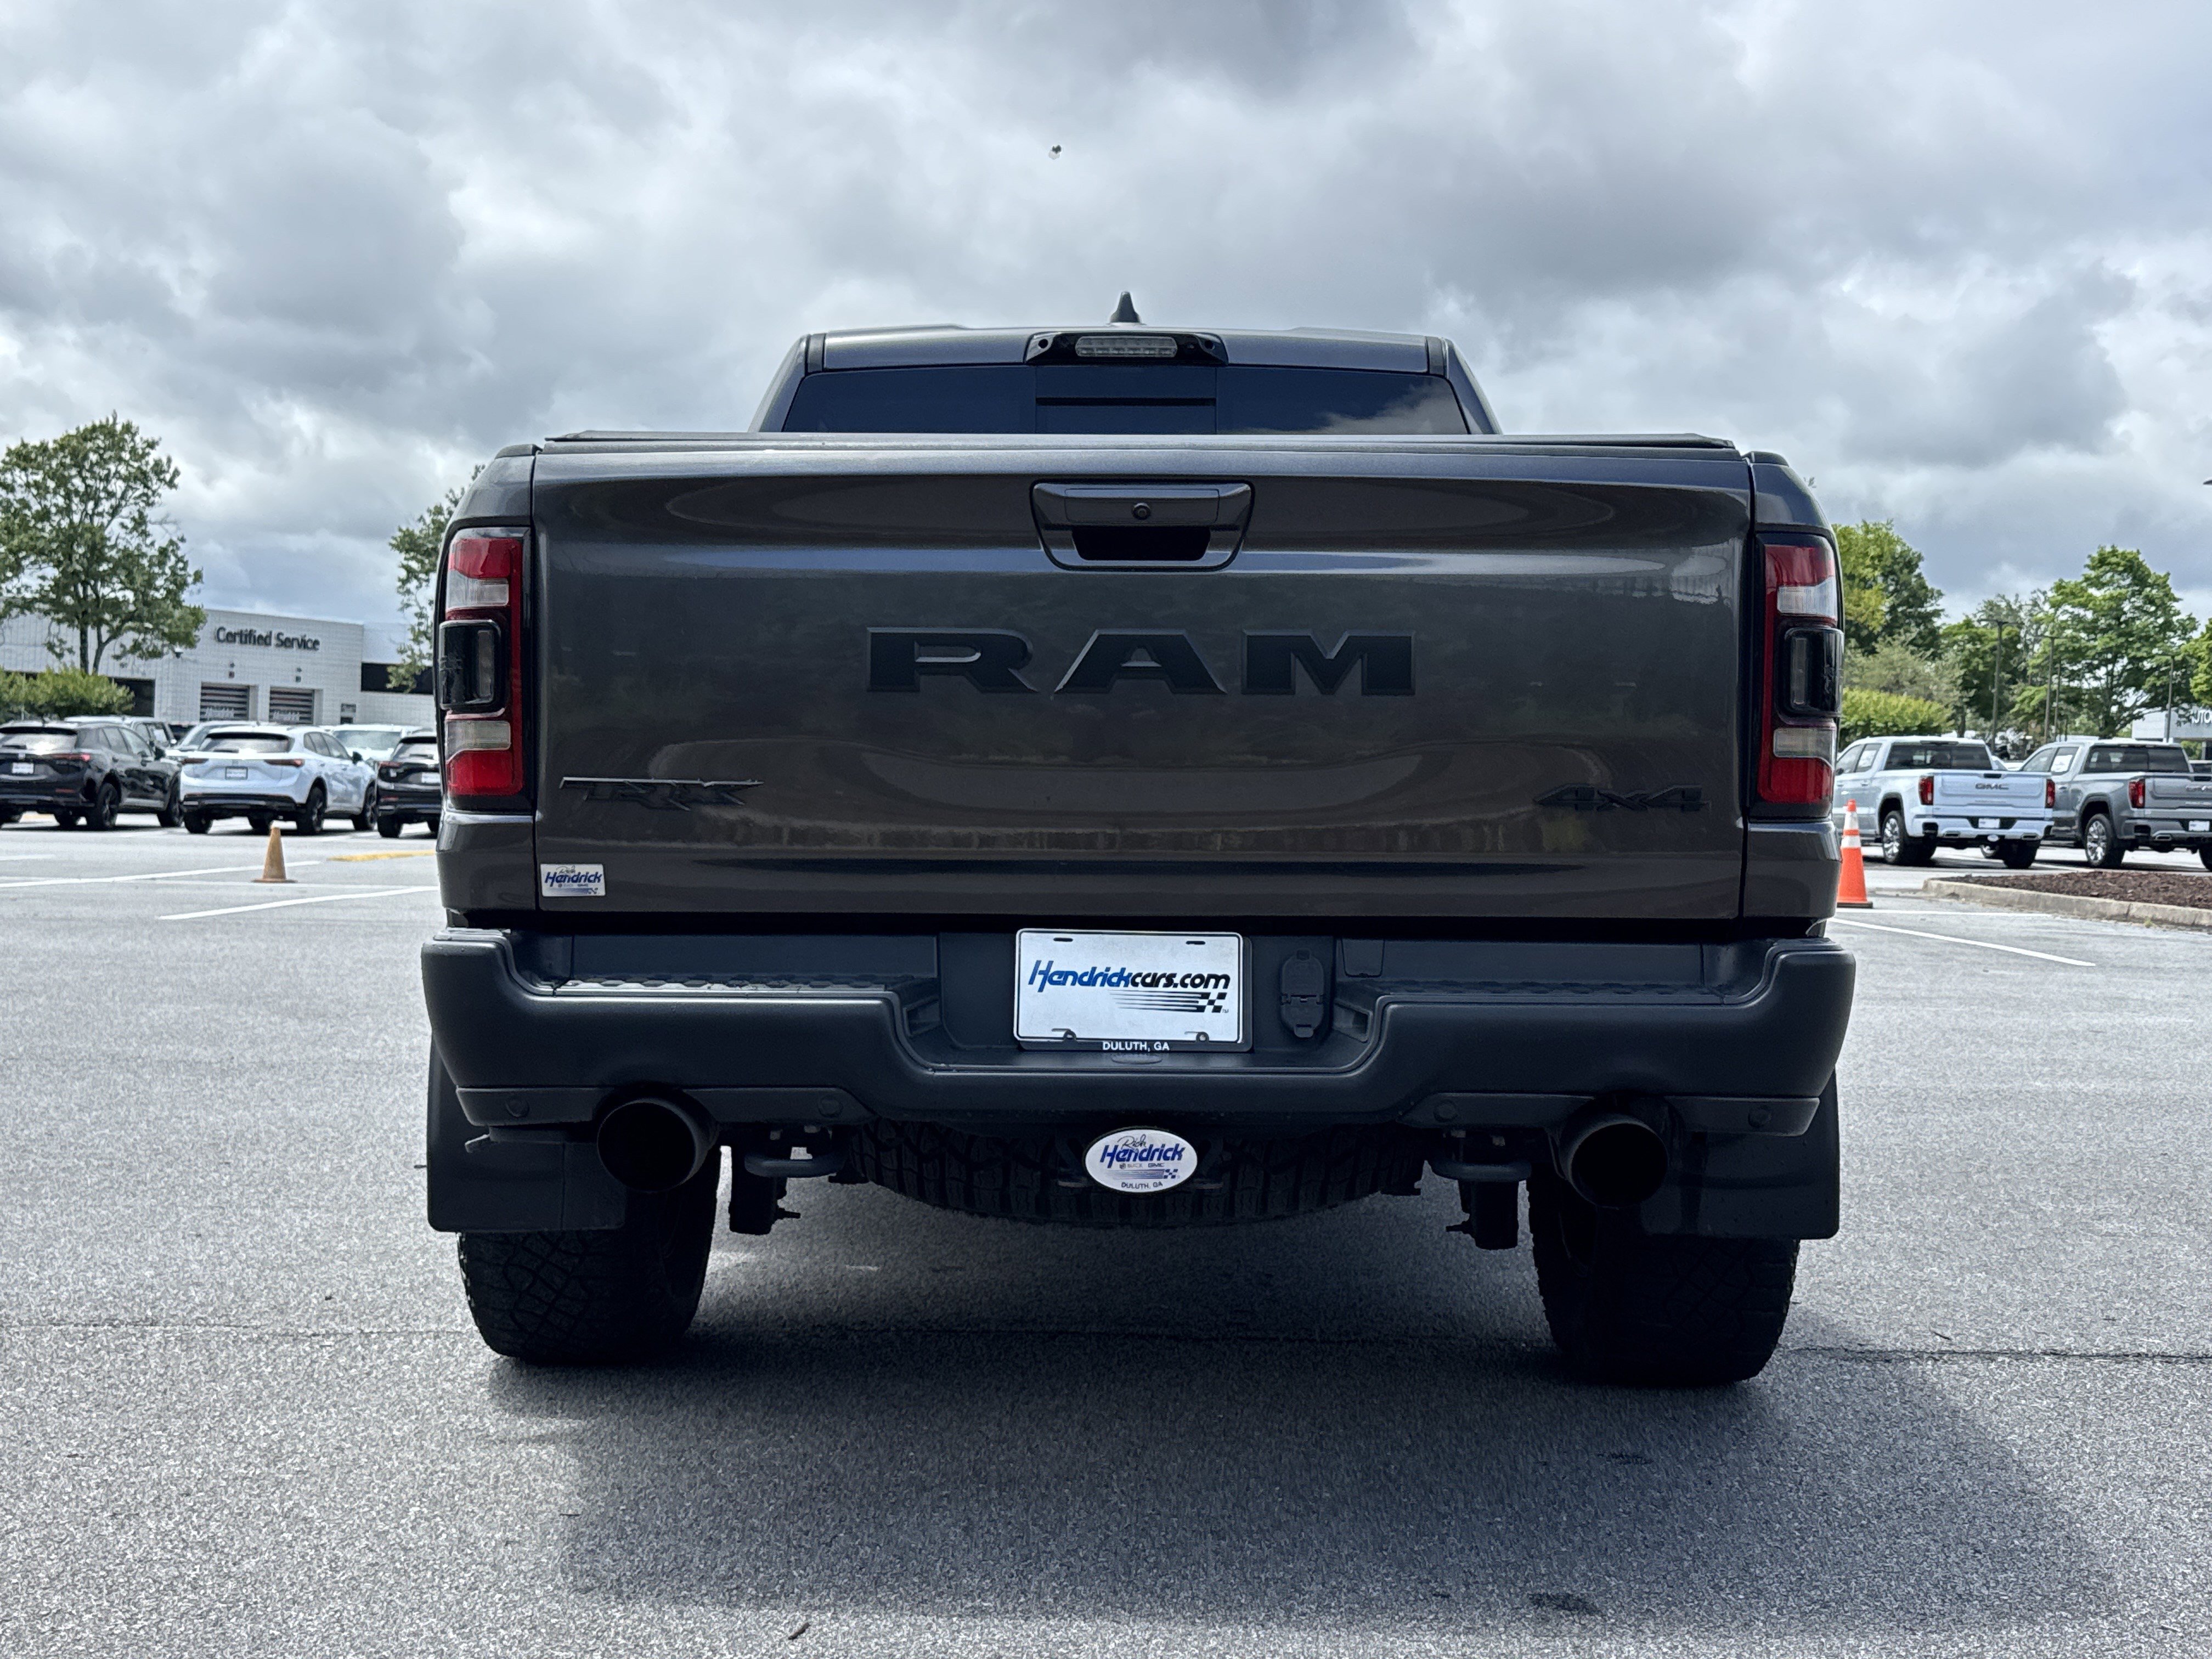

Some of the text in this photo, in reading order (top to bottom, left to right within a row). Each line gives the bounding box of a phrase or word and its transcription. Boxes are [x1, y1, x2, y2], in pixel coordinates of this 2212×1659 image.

[216, 627, 320, 651] Certified Service
[866, 627, 1415, 696] RAM
[545, 871, 602, 887] Hendrick
[1028, 960, 1231, 992] Hendrickcars.com
[1102, 1041, 1170, 1052] DULUTH, GA
[1099, 1143, 1186, 1169] Hendrick
